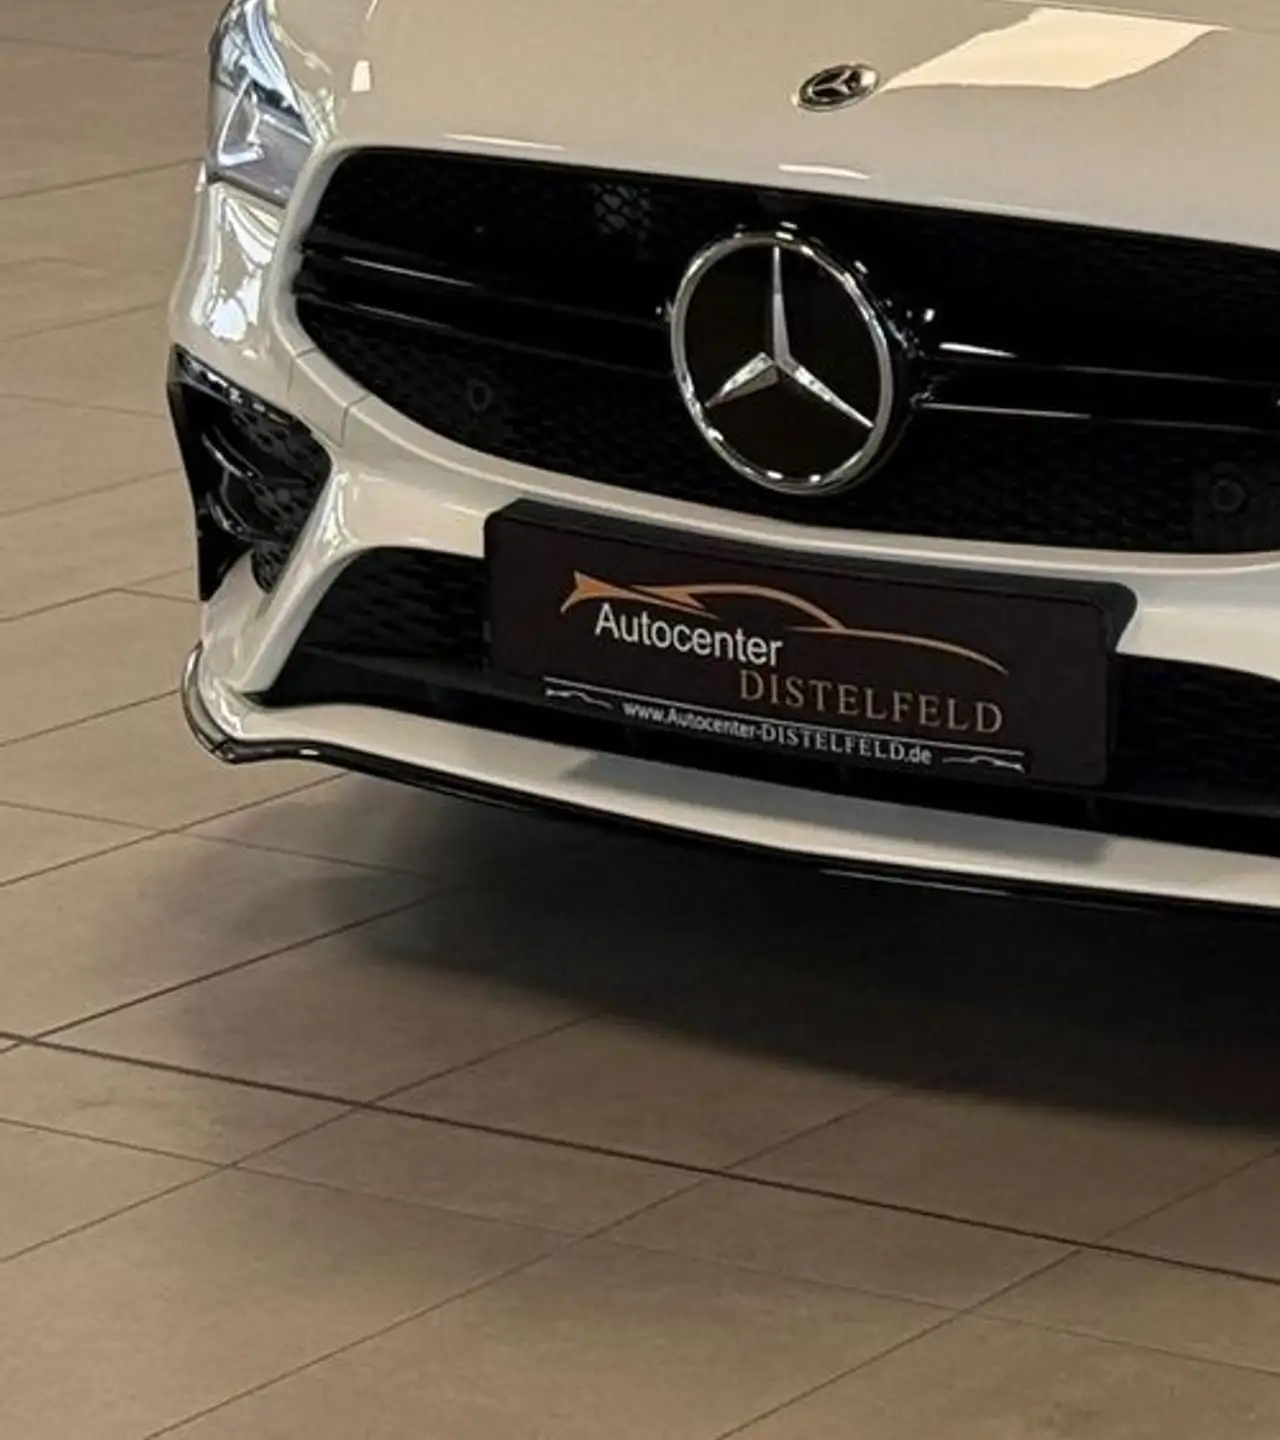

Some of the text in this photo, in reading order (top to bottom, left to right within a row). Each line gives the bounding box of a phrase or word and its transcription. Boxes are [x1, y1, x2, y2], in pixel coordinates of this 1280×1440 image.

[594, 602, 784, 666] Autocenter
[621, 700, 932, 765] www.Autocenter-DISTELFELD.de
[738, 668, 1003, 735] DISTELFELD
